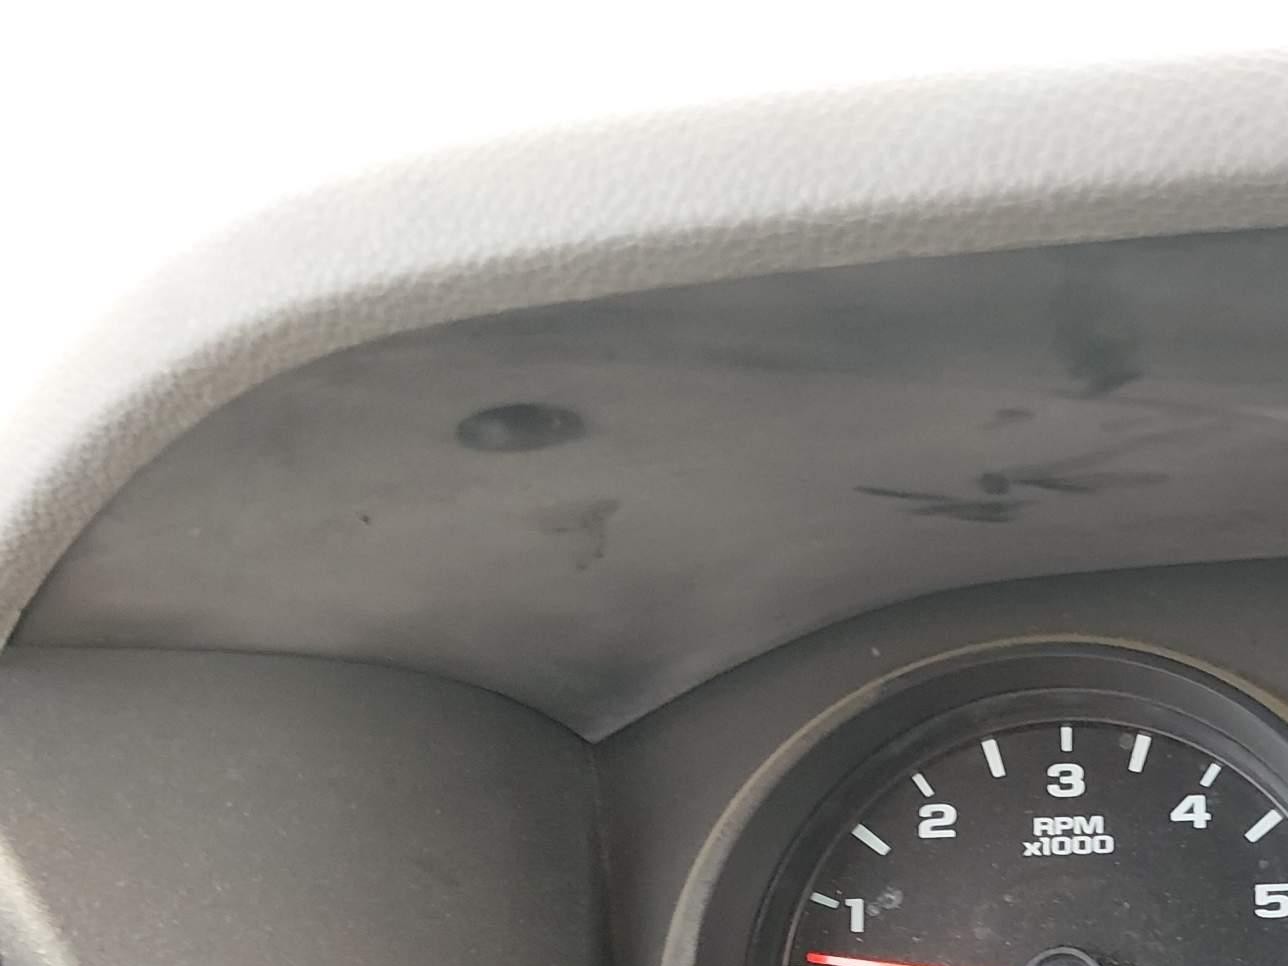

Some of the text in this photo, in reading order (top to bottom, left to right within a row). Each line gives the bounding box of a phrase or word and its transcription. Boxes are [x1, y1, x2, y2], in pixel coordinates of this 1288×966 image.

[1047, 763, 1085, 798] 3
[918, 803, 957, 839] 2
[1032, 815, 1104, 837] RPM
[1170, 795, 1212, 829] 4
[1022, 834, 1114, 857] x1000
[844, 898, 865, 933] 1
